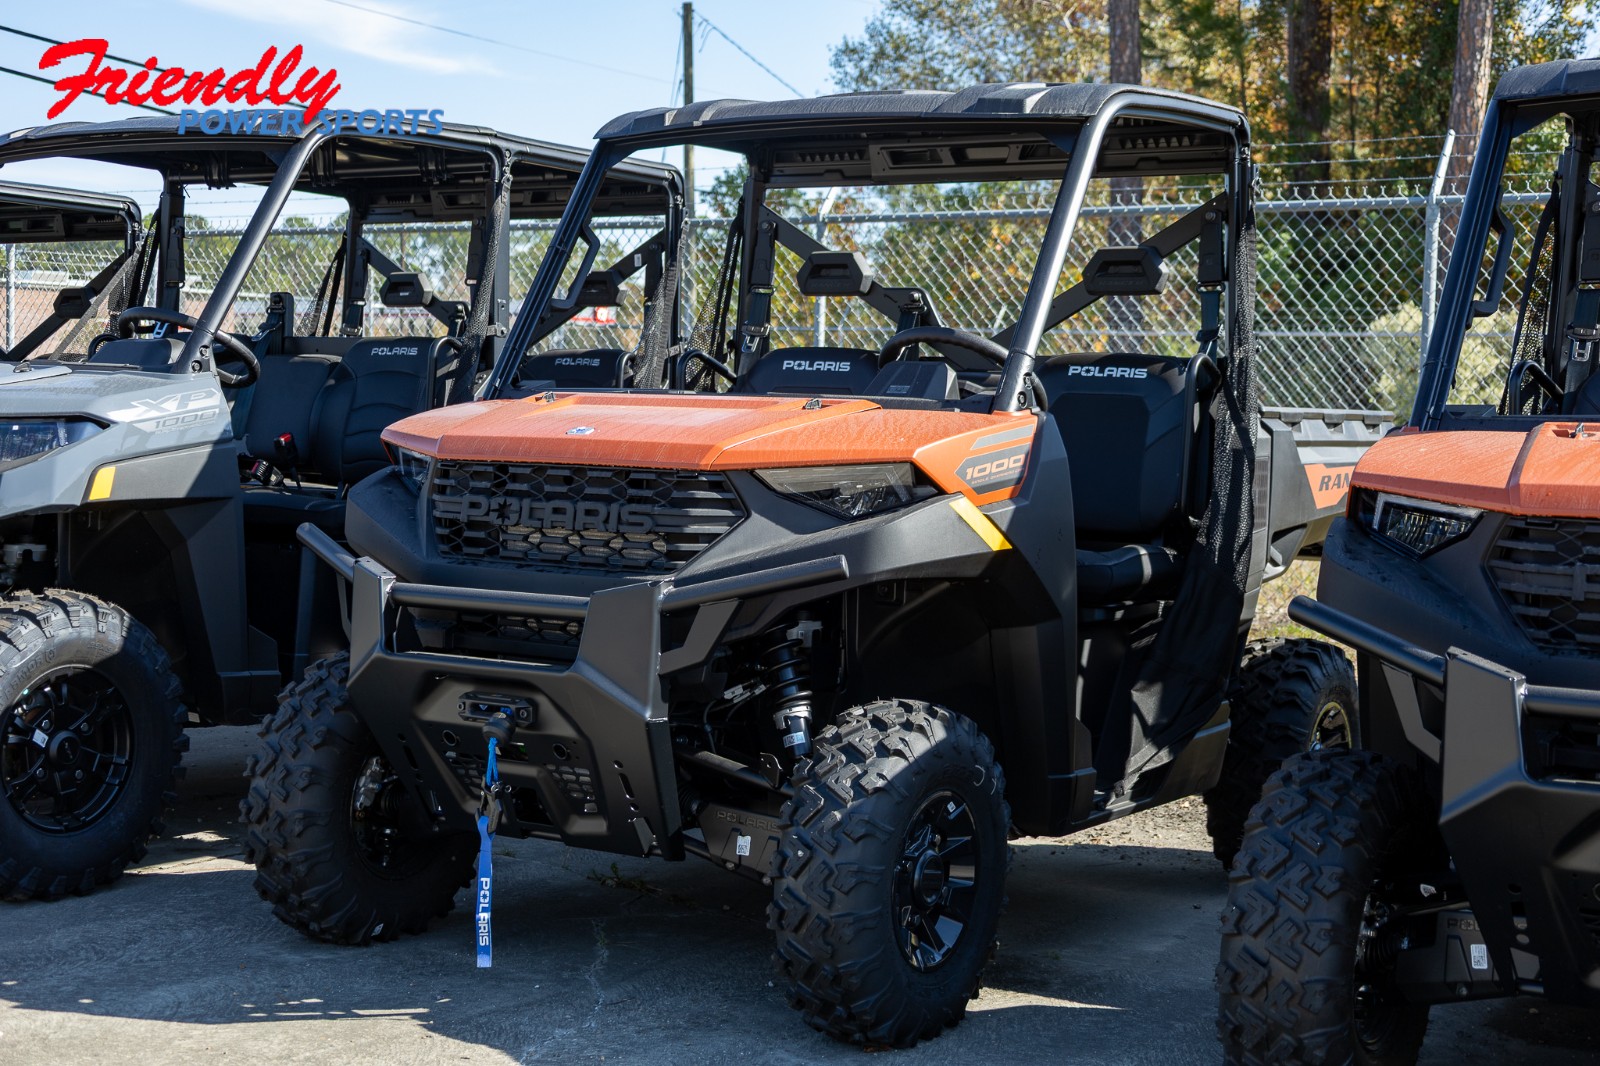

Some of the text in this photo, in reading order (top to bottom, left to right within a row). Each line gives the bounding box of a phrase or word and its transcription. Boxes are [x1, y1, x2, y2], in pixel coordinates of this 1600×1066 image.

[371, 347, 418, 356] POLARIS
[555, 357, 600, 366] POLARIS
[782, 360, 851, 372] POLARIS
[1067, 364, 1148, 379] POLARIS
[130, 388, 219, 417] XP
[155, 410, 218, 429] 1000
[966, 454, 1026, 480] 1000
[460, 494, 656, 534] POLARIS
[717, 809, 782, 833] POLARIS
[478, 877, 491, 947] POLARIS
